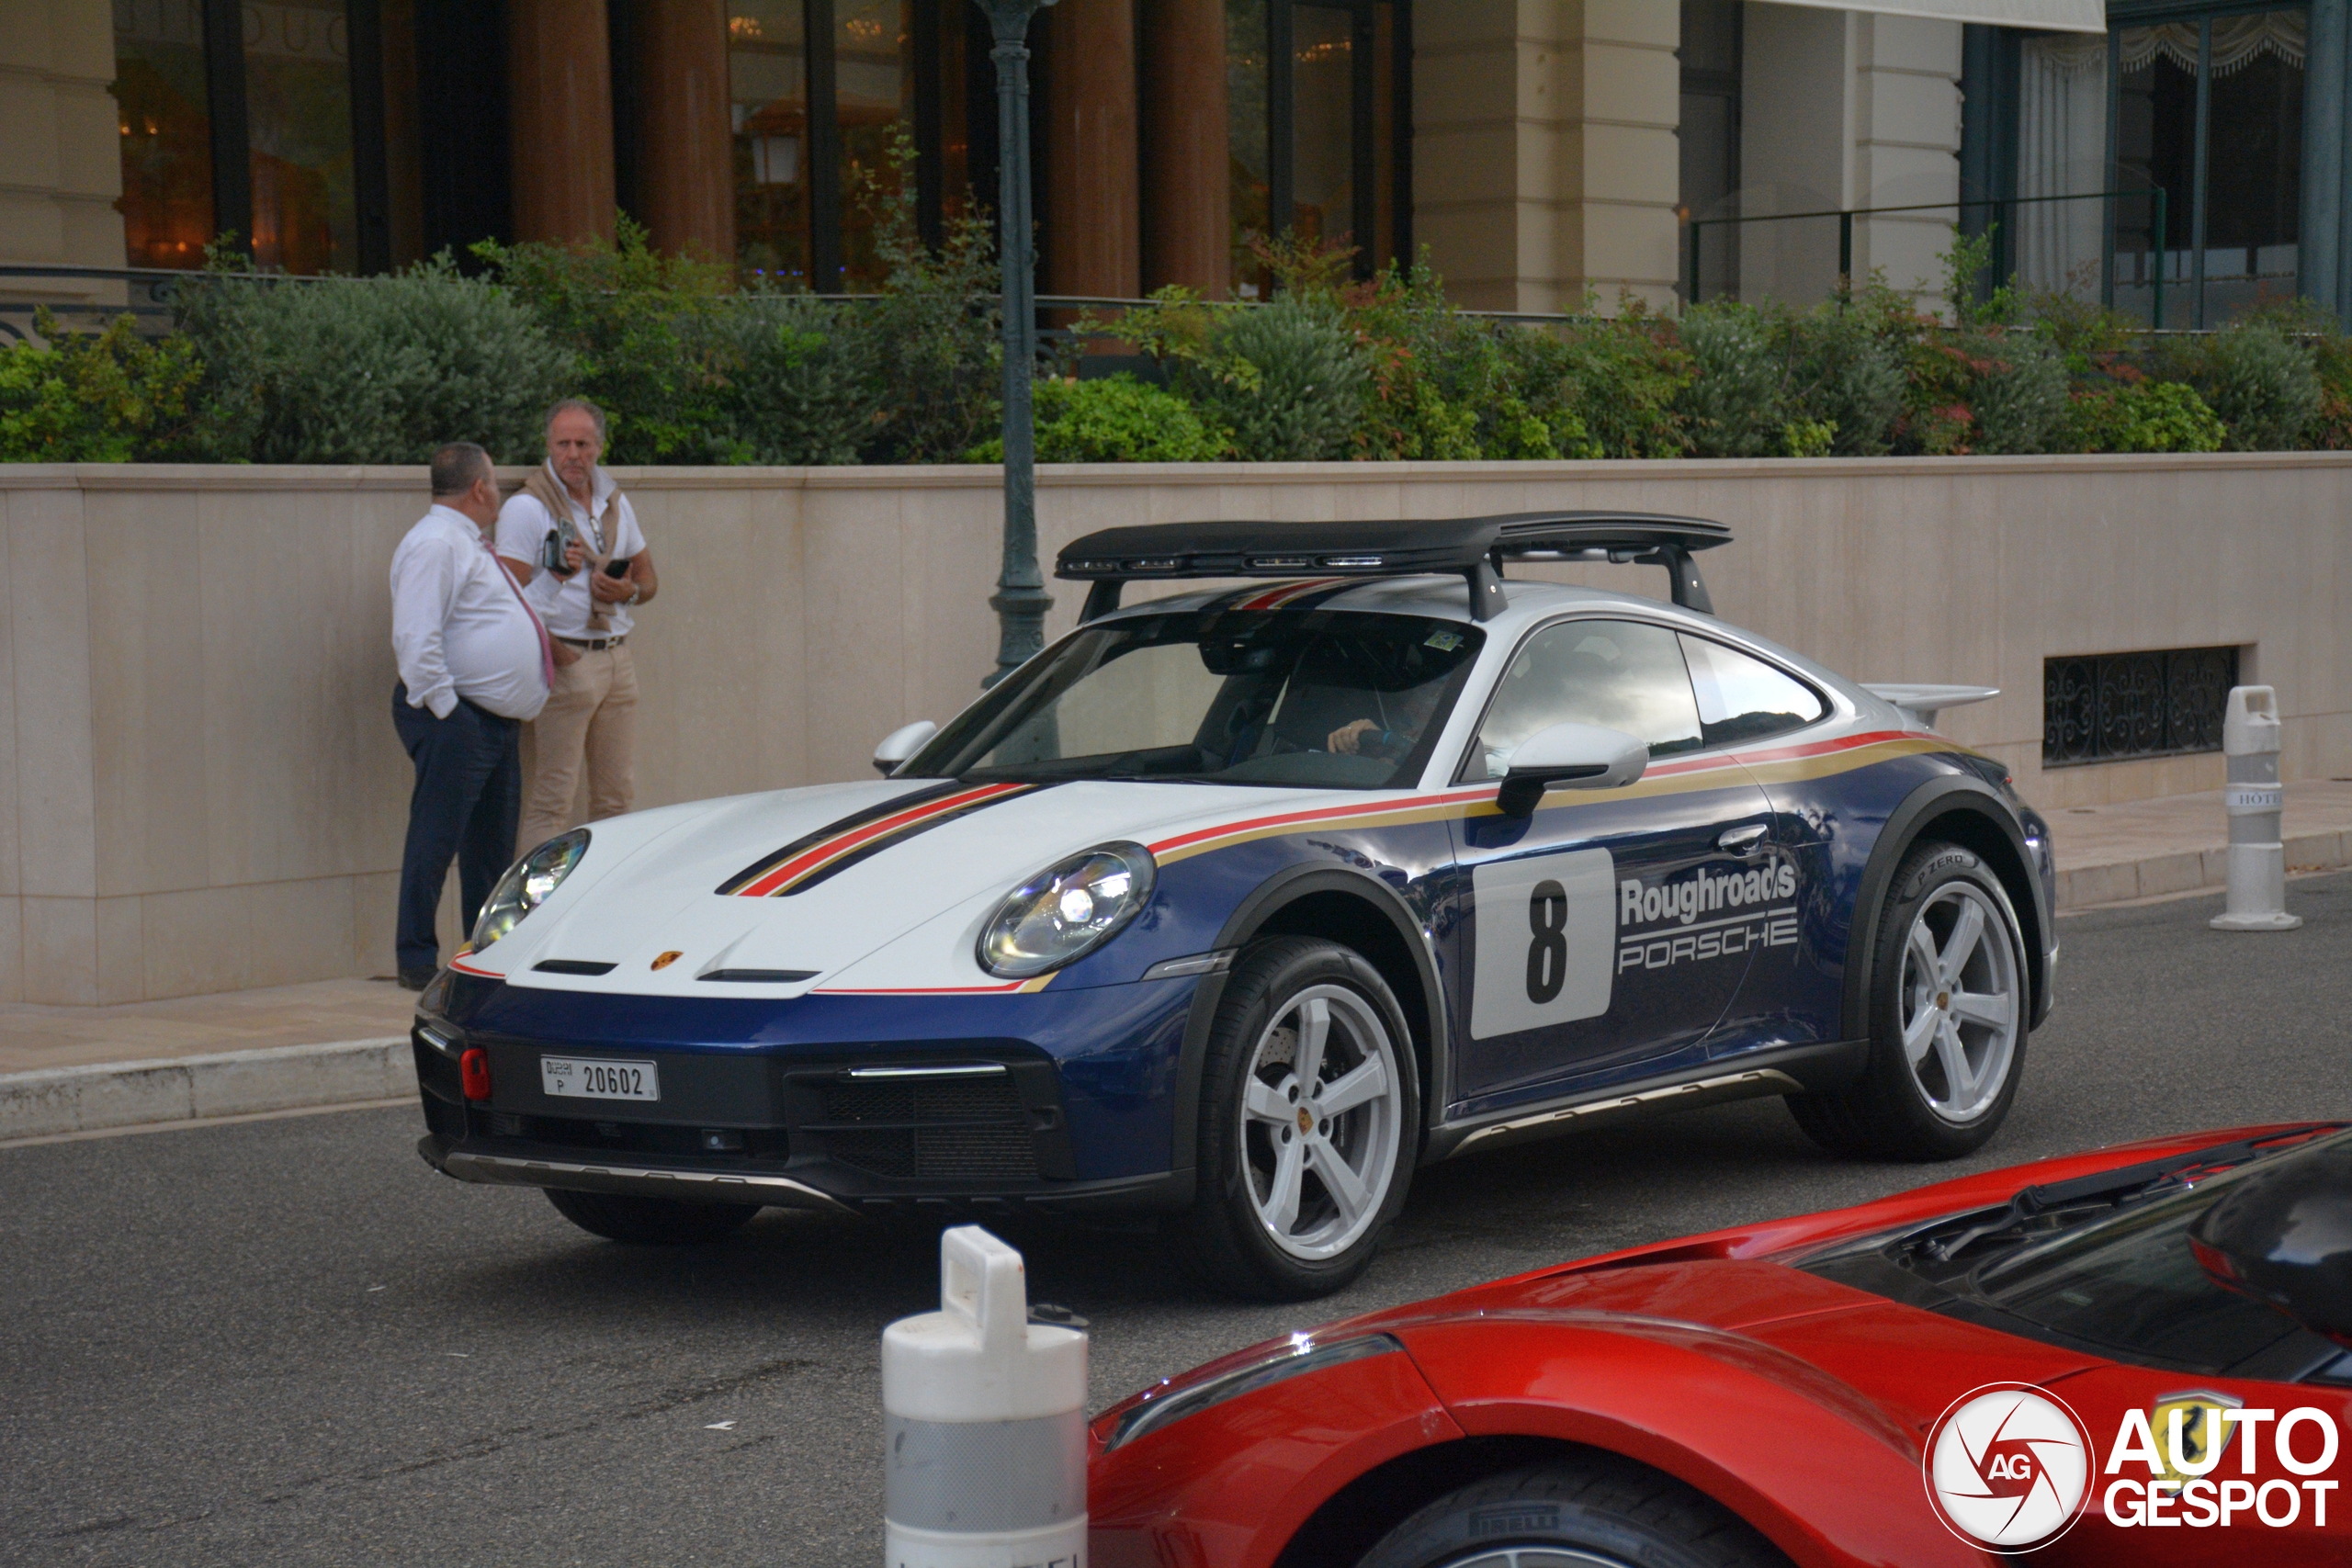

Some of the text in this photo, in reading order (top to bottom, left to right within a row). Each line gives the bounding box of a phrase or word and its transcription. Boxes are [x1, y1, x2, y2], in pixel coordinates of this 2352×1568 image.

[1928, 854, 1963, 874] ZERO
[1621, 856, 1796, 926] Roughroads
[1526, 879, 1568, 1004] 8
[1618, 919, 1798, 975] PORSCHE
[557, 1079, 564, 1093] P
[583, 1066, 643, 1095] 20602
[1468, 1505, 1560, 1538] PIRELLI
